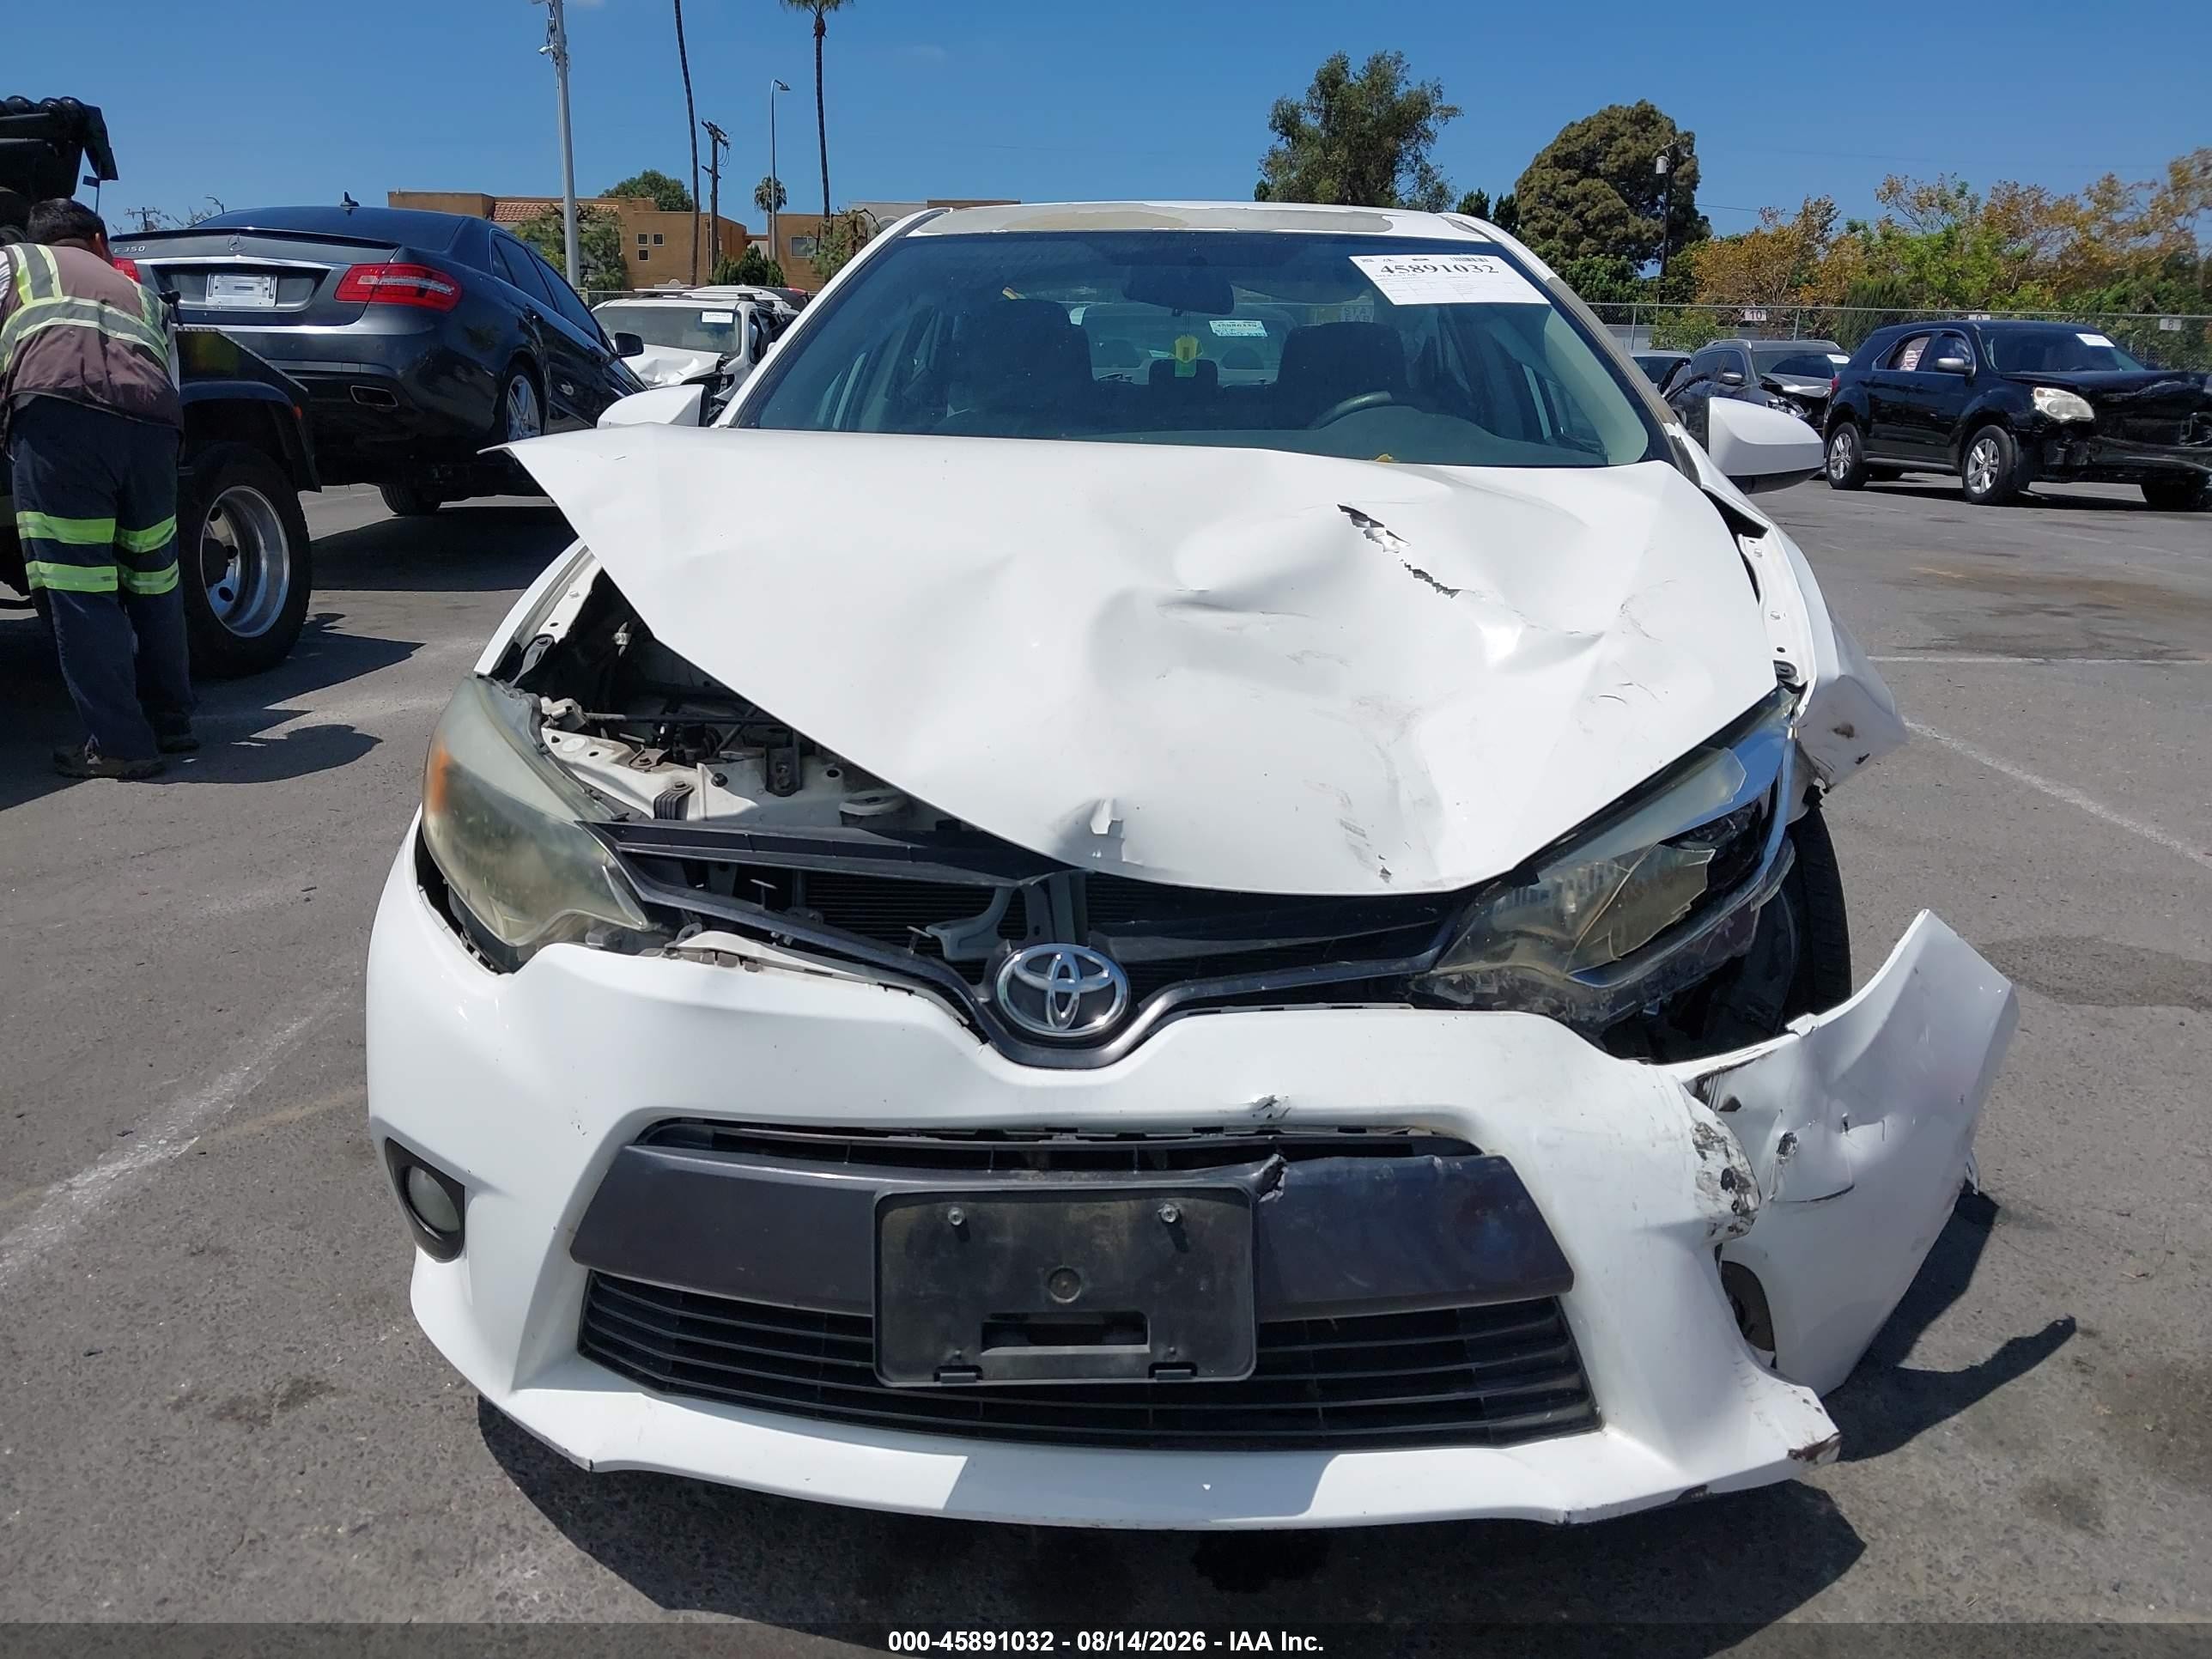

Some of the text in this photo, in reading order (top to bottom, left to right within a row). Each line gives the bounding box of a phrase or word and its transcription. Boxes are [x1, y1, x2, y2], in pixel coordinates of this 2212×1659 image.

[124, 245, 146, 253] 350
[1380, 264, 1499, 274] 45891032
[1750, 310, 1763, 320] 10
